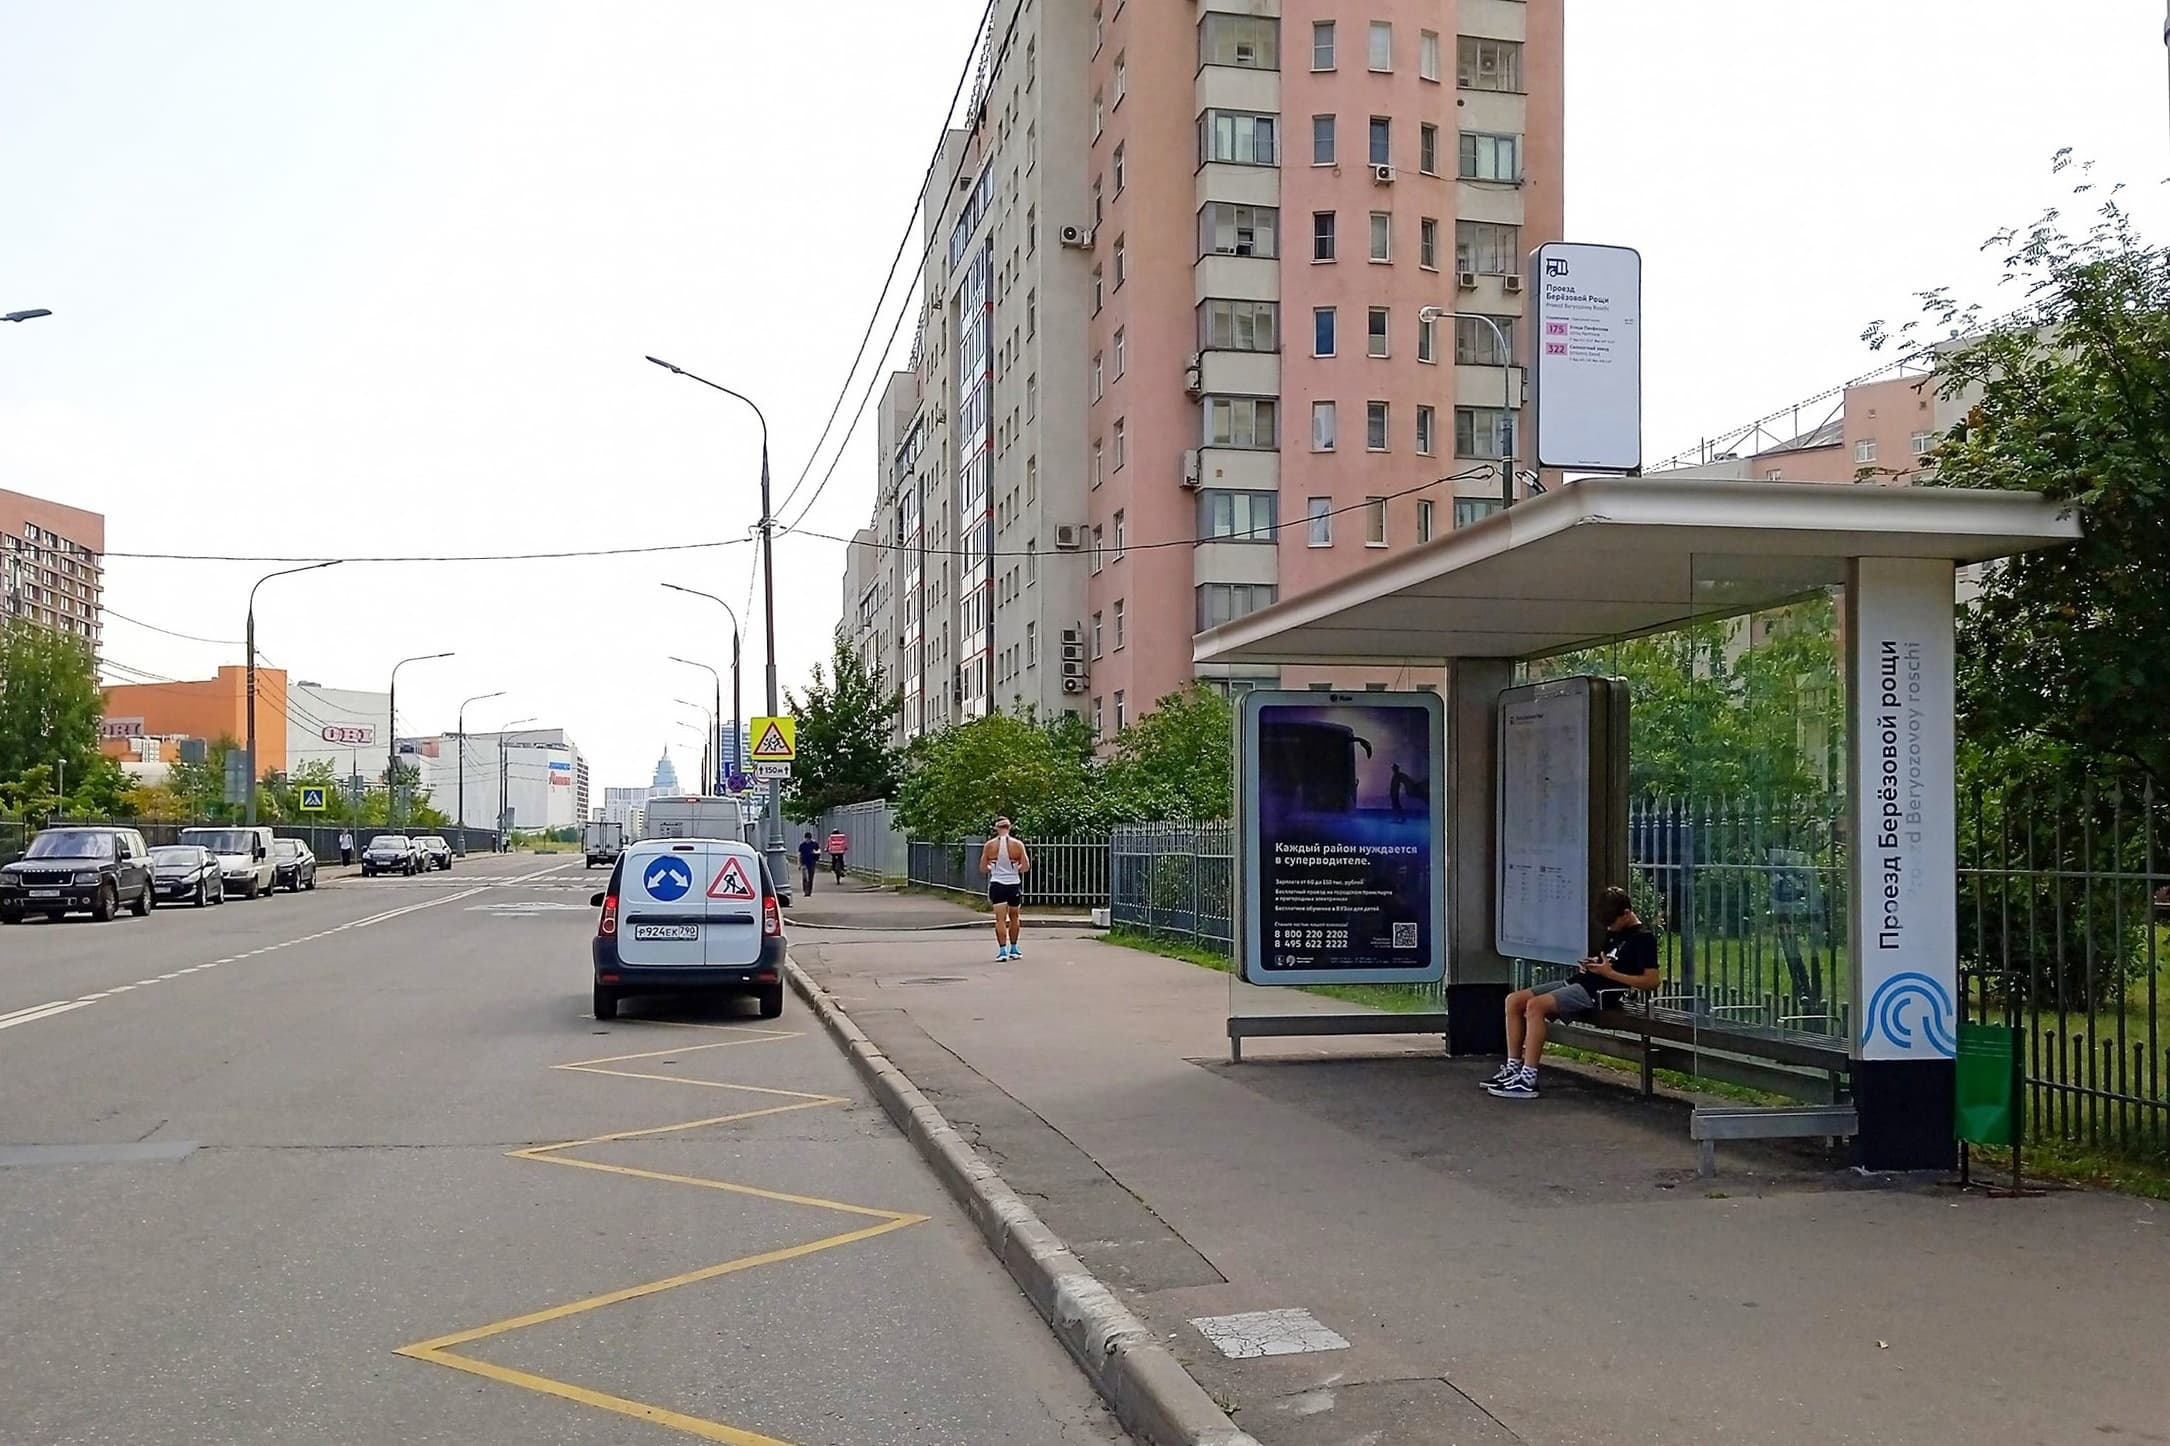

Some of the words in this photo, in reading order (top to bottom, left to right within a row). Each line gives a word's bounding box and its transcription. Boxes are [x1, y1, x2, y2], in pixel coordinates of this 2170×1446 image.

[1546, 284, 1575, 293] Проезд
[1546, 292, 1587, 302] Берёзовой
[1588, 295, 1609, 304] Рощи
[1549, 324, 1564, 334] 175
[1548, 344, 1565, 354] 322
[1881, 641, 1902, 707] рощи
[1903, 642, 1921, 702] roschi
[322, 726, 373, 743] OBI
[764, 766, 778, 774] 150
[1905, 708, 1925, 824] Beryozovoy
[1877, 715, 1903, 848] Берёзовой
[1275, 842, 1321, 854] Каждый
[1323, 844, 1357, 854] район
[1359, 845, 1418, 855] нуждается
[1275, 856, 1282, 864] в
[1284, 857, 1371, 867] суперводителе.
[1879, 856, 1904, 949] Проезд
[679, 926, 696, 935] 790
[1274, 930, 1281, 938] 8
[1284, 930, 1302, 938] 800
[1305, 930, 1323, 939] 220
[1325, 930, 1349, 939] 2202
[1274, 940, 1281, 948] 8
[1284, 940, 1302, 948] 495
[1304, 940, 1322, 948] 622
[1325, 940, 1349, 948] 2222
